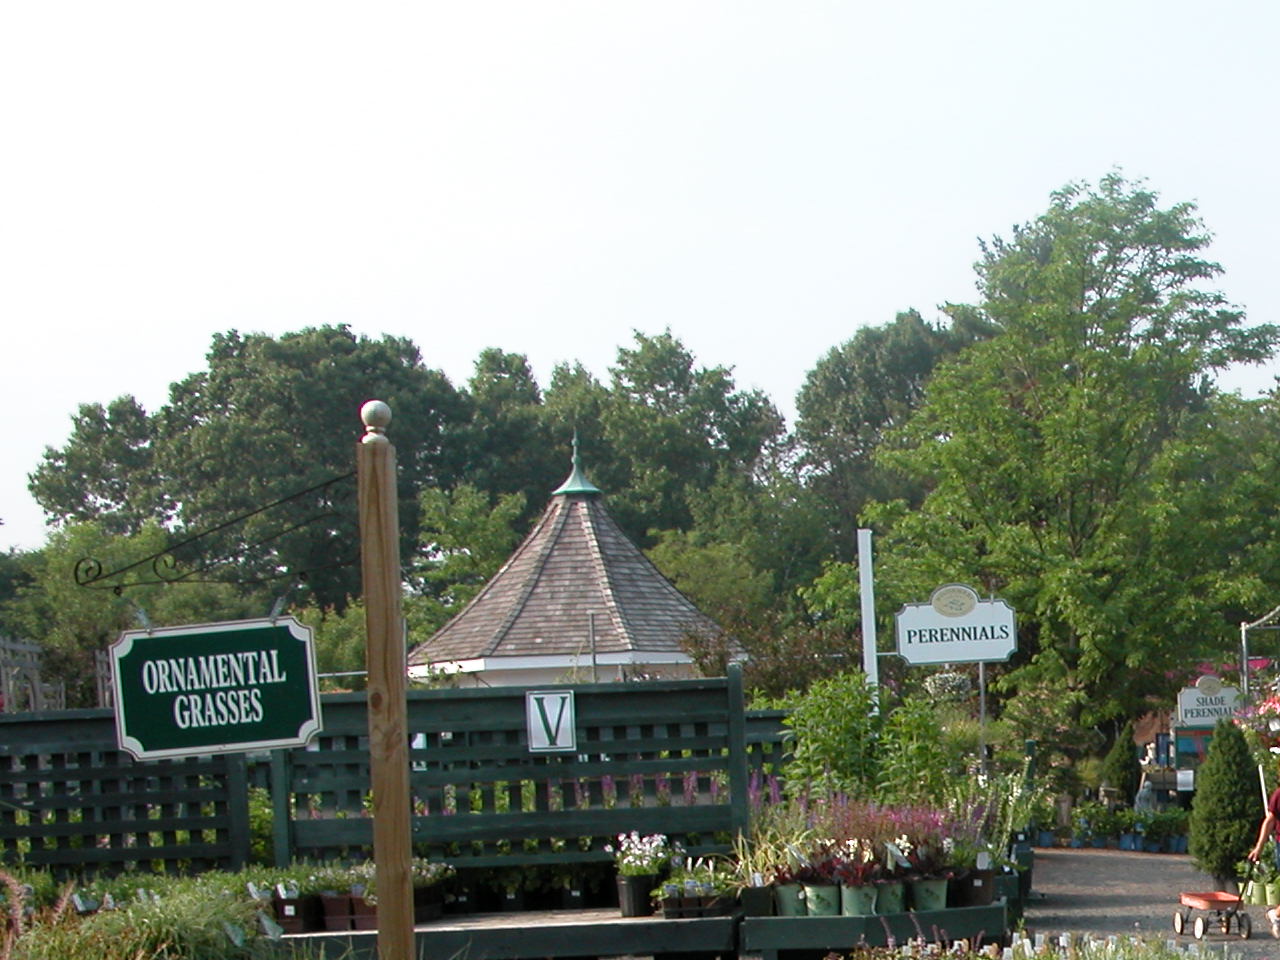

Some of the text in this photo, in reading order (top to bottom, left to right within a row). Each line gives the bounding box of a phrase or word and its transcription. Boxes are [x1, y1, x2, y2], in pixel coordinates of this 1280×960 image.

[906, 625, 1009, 644] PERENNIALS
[142, 650, 287, 694] ORNAMENTAL
[174, 688, 264, 729] GRASSES
[533, 695, 569, 747] V
[1196, 696, 1226, 707] SHADE
